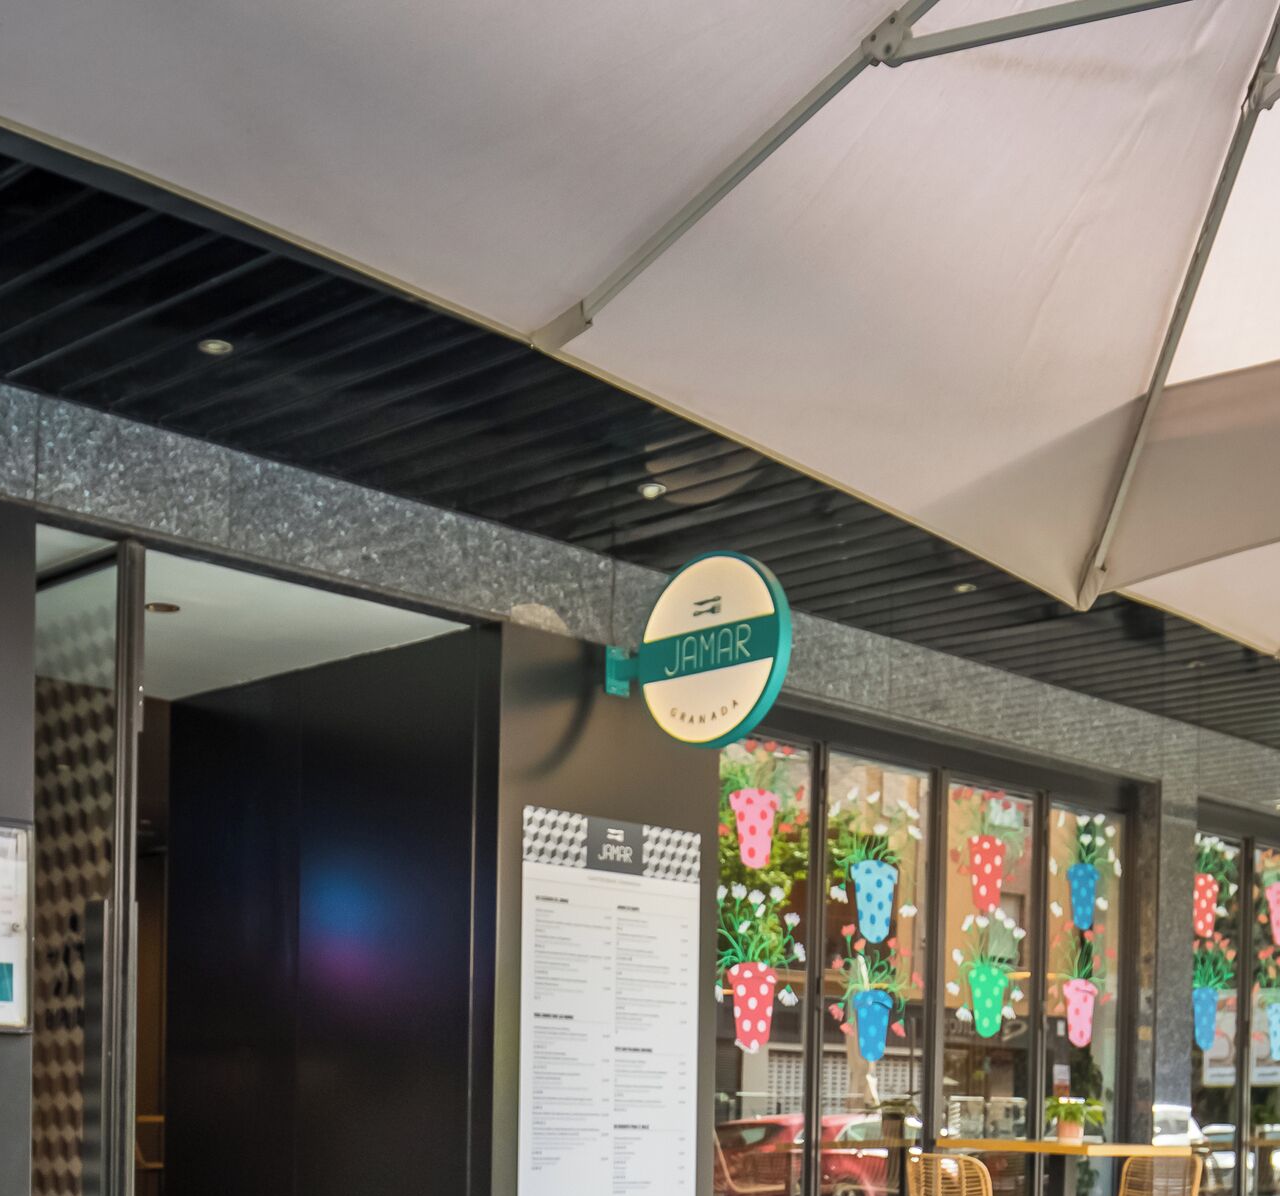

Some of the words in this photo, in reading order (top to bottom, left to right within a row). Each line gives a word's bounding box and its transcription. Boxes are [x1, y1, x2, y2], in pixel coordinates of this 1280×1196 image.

[664, 623, 752, 677] JAMAR
[670, 699, 739, 725] GRANADA
[597, 845, 633, 864] JAMAR
